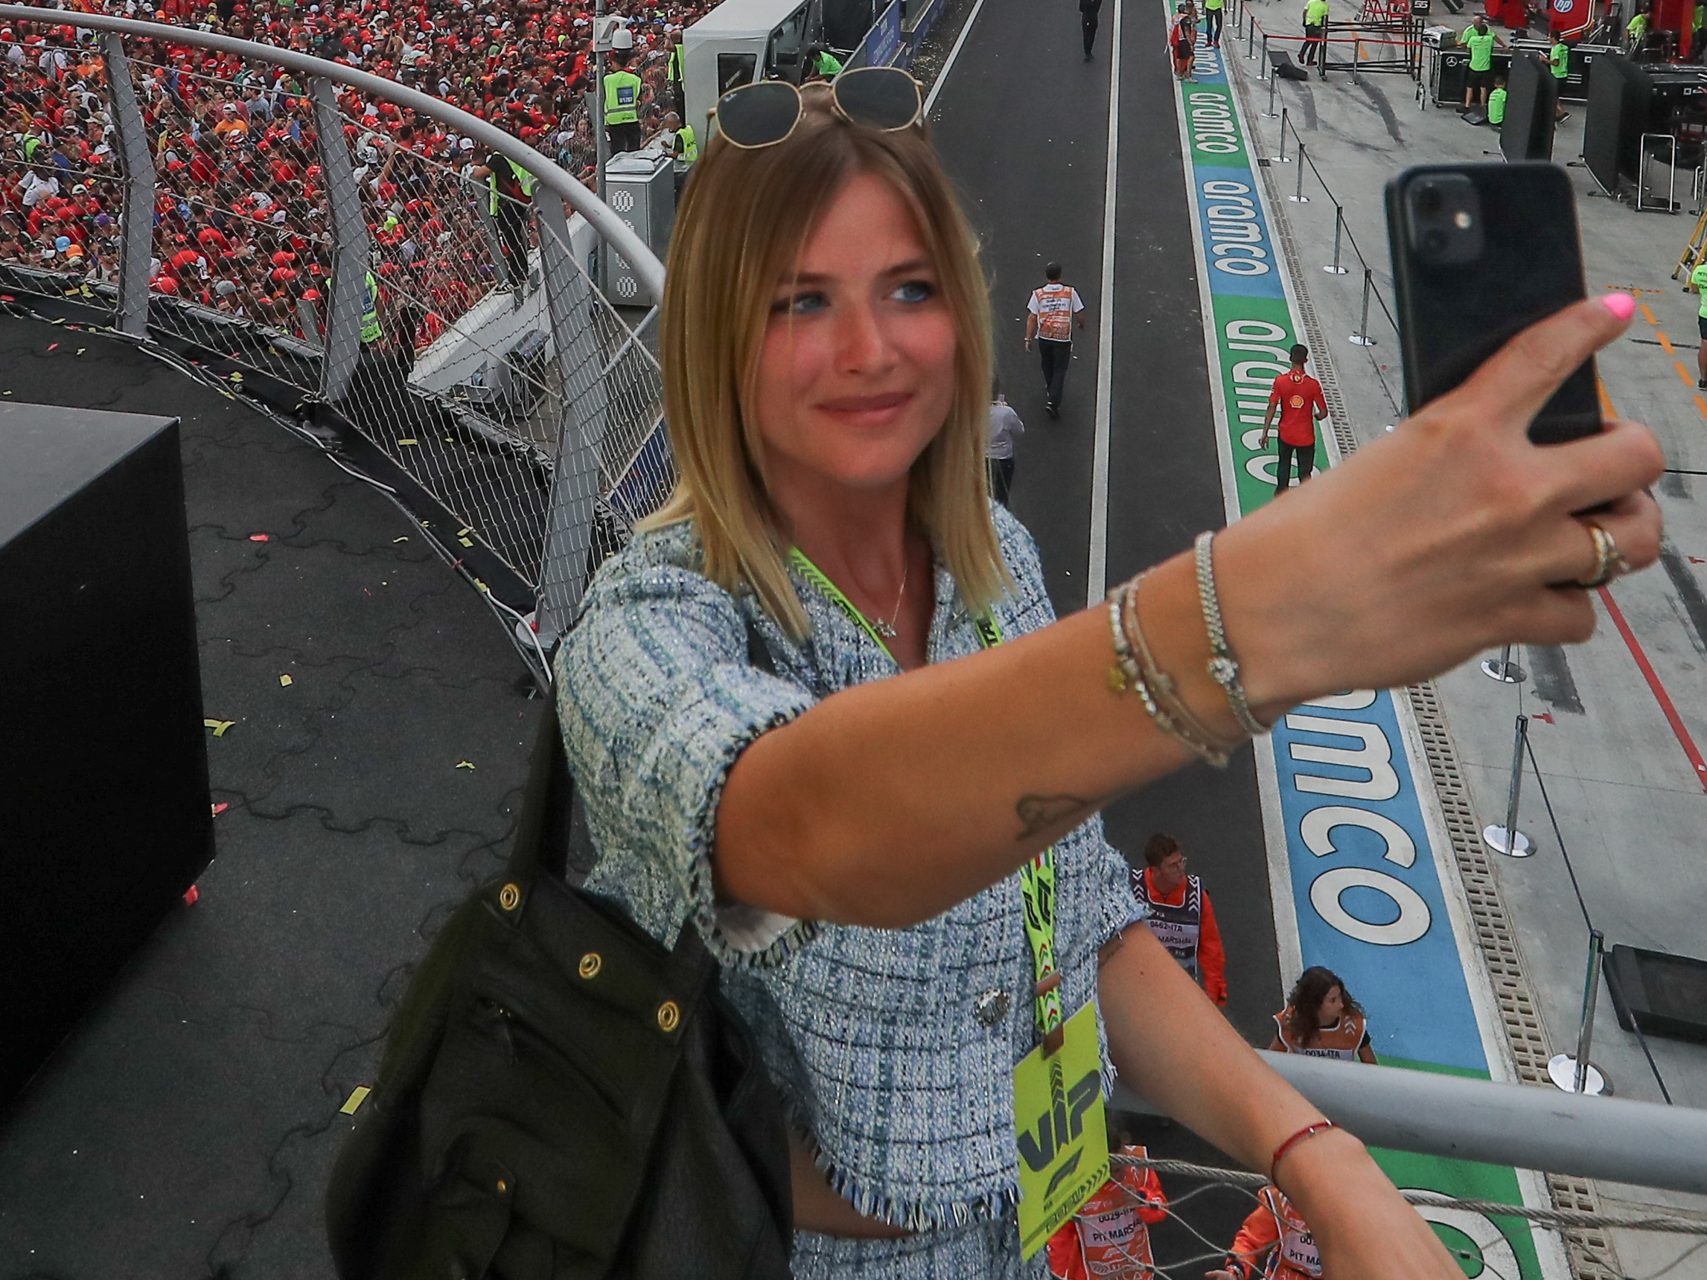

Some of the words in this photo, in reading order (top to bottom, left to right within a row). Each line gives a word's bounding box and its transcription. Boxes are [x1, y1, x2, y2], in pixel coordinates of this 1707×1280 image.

[1414, 1, 1429, 9] 55
[1189, 92, 1239, 153] aramco
[1203, 181, 1270, 276] aramco
[1017, 1066, 1101, 1172] VIP
[1290, 1249, 1305, 1262] PIT
